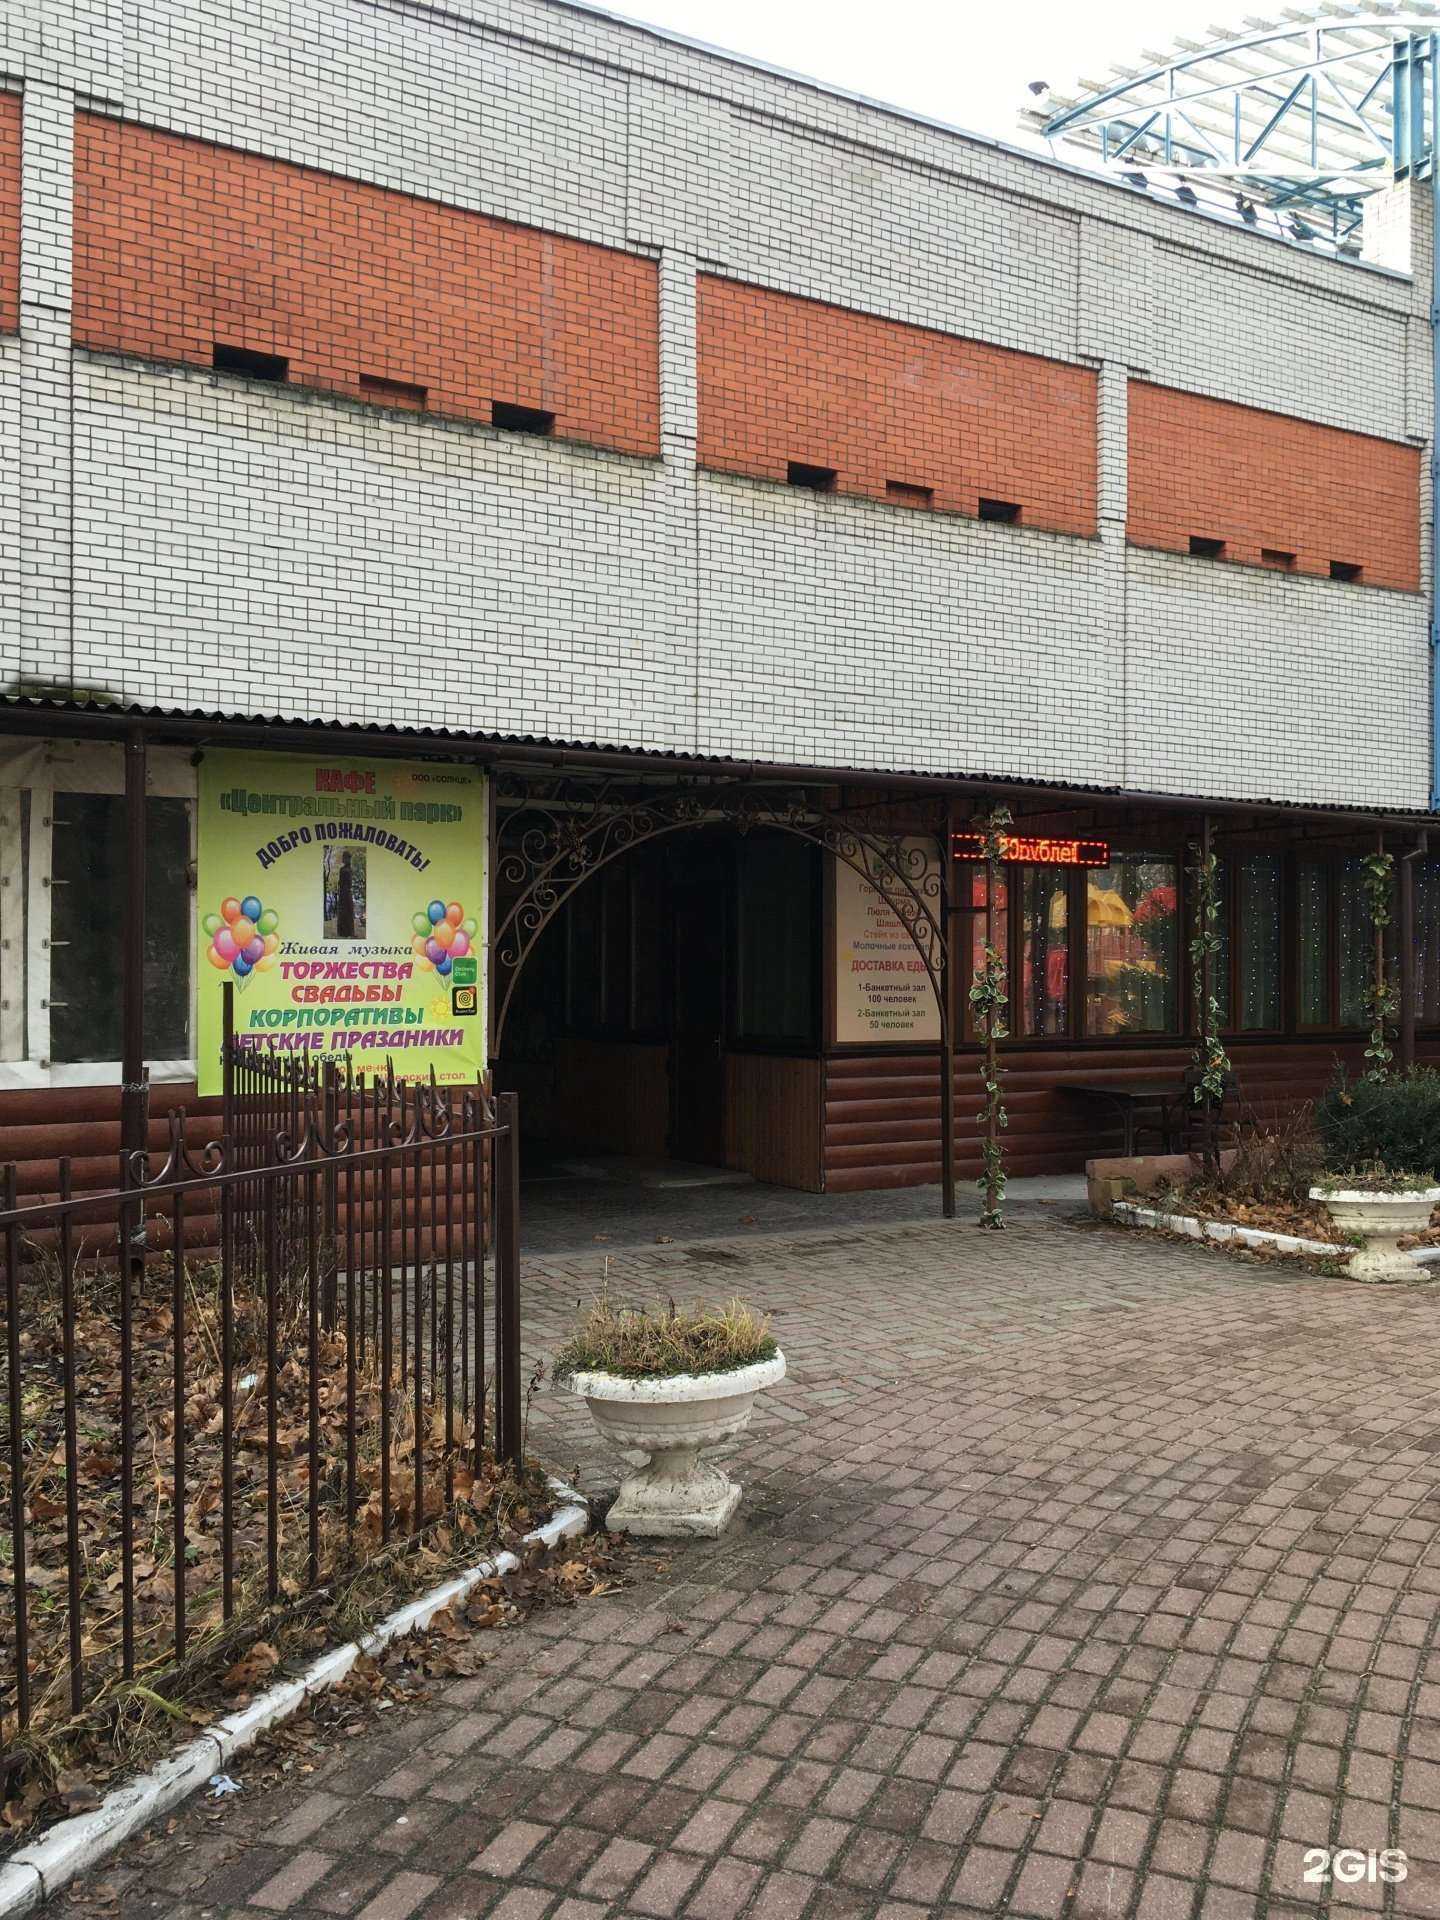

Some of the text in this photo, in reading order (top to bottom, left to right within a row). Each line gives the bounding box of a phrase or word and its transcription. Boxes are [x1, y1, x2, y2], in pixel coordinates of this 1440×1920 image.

[315, 768, 376, 794] КАФЕ
[220, 789, 463, 824] «Центральный парк»
[255, 822, 431, 872] ДОБРО ПОЖАЛОВАТЬ!
[279, 942, 413, 957] Живая музыка
[280, 961, 414, 980] ТОРЖЕСТВА
[851, 960, 904, 972] ДОСТАВКА
[291, 984, 403, 1004] СВАДЬБЫ
[868, 995, 917, 1004] 100 человек
[249, 1007, 425, 1029] КОРПОРАТИВЫ
[869, 1020, 914, 1029] 50 человек
[330, 1029, 465, 1050] ПРАЗДНИКИ
[440, 1072, 466, 1081] стол
